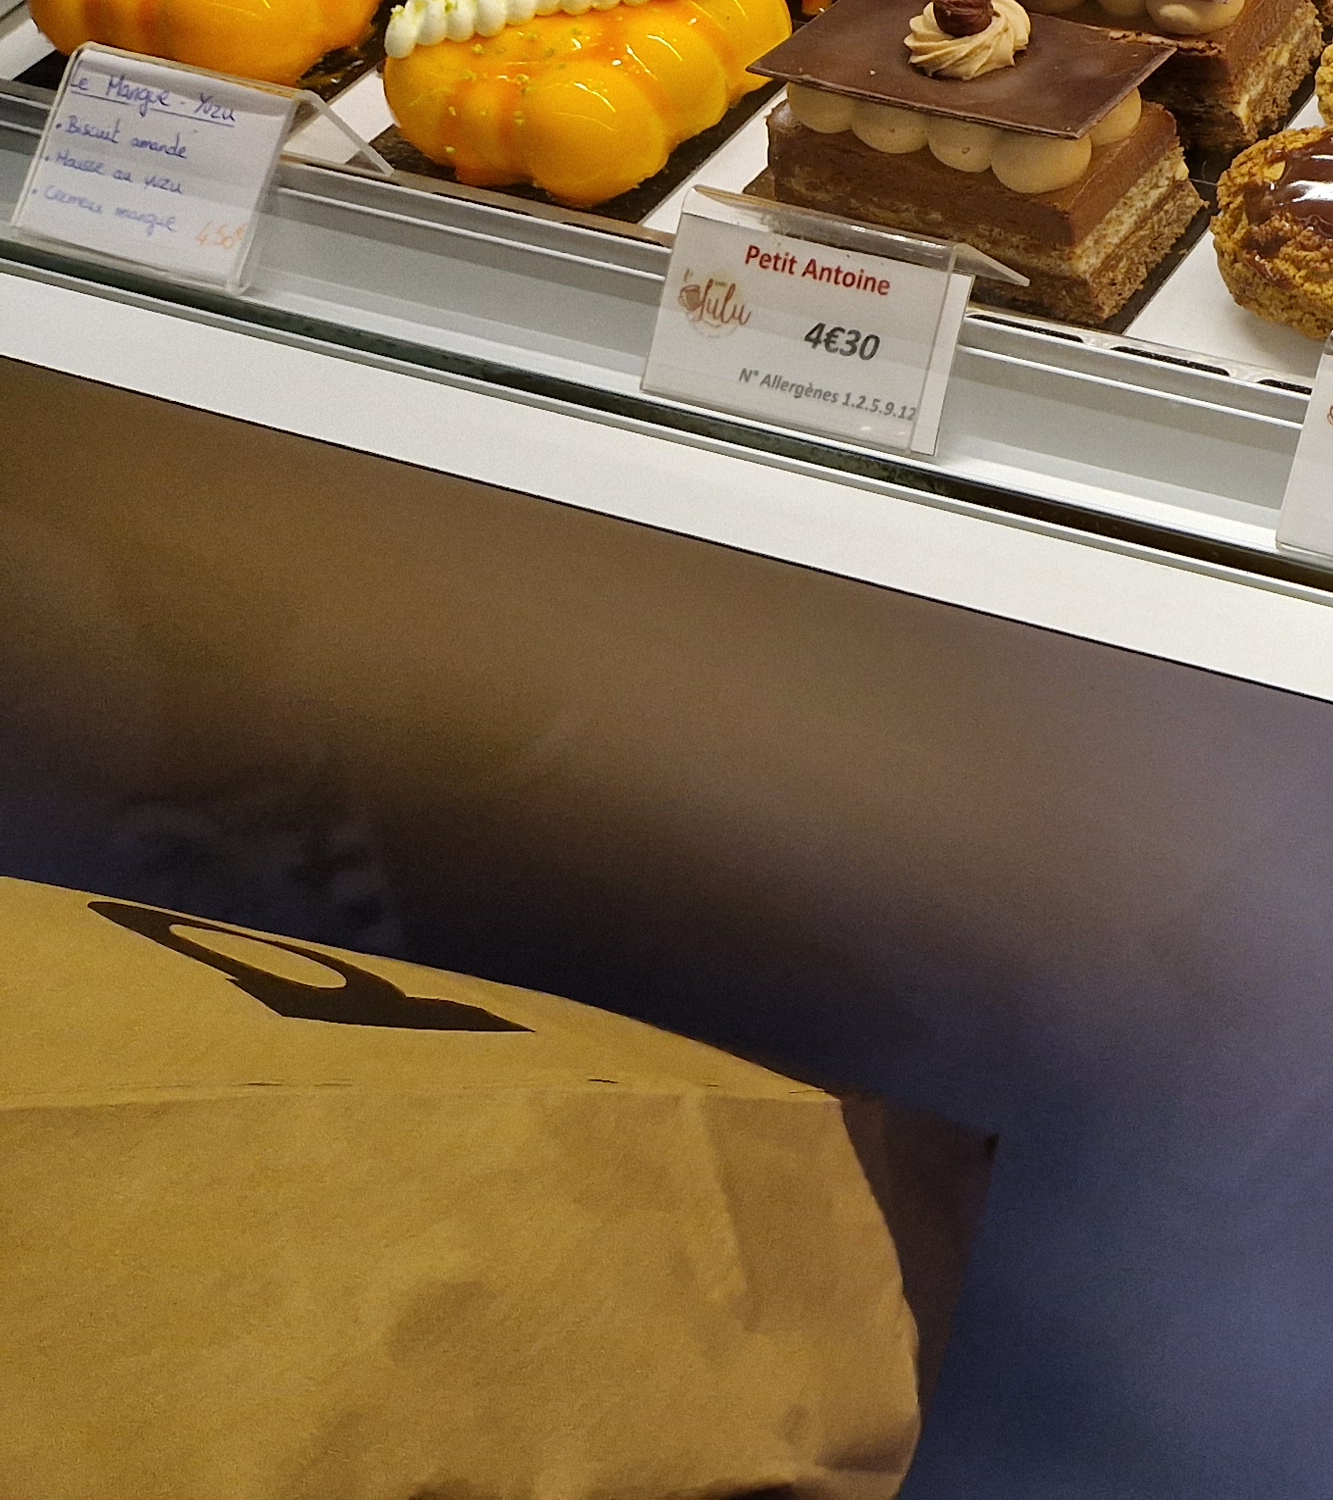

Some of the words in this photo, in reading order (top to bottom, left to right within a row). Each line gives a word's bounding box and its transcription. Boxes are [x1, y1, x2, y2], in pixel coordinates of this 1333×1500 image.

[67, 114, 120, 145] Biscuit
[131, 134, 188, 160] amande
[113, 169, 133, 183] au
[744, 244, 799, 276] Petit
[801, 258, 892, 296] Antoine
[804, 322, 881, 360] 4€30
[738, 367, 759, 384] N°
[760, 373, 840, 404] Allergènes
[842, 392, 917, 421] 1.2.5.9.12
